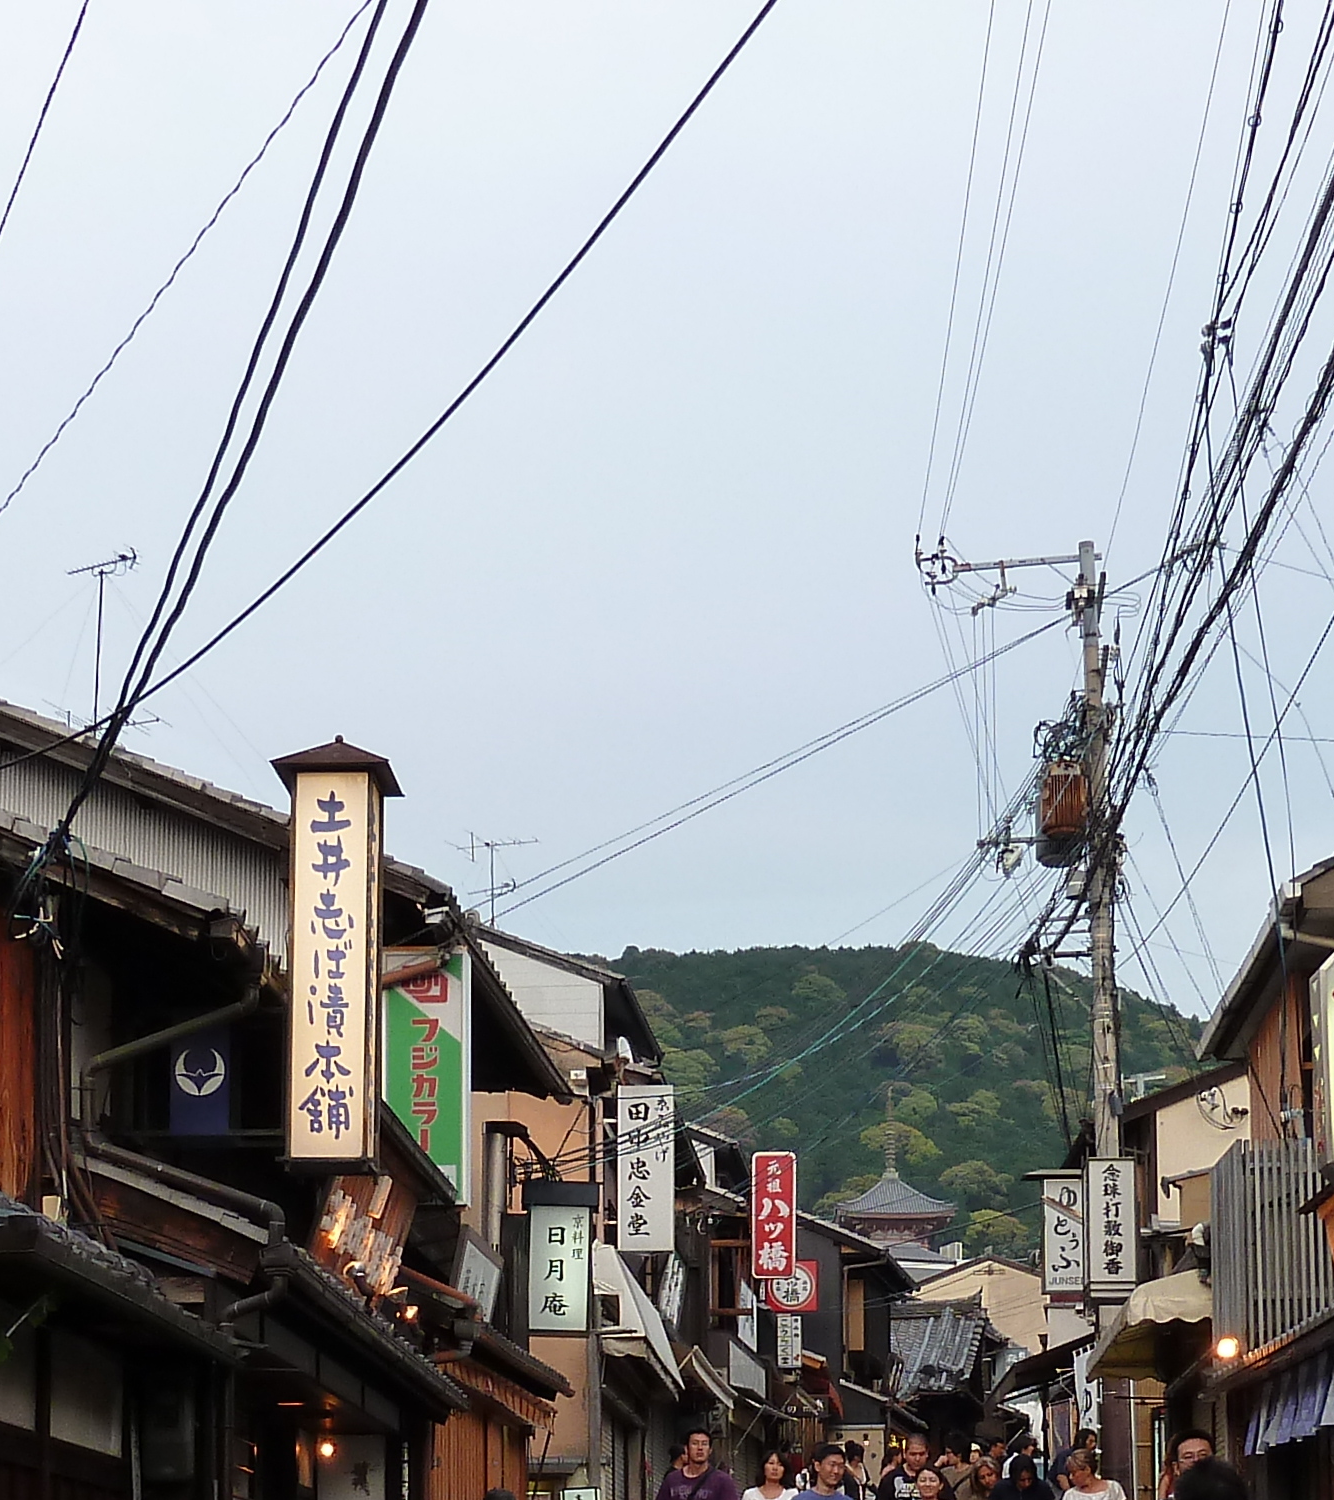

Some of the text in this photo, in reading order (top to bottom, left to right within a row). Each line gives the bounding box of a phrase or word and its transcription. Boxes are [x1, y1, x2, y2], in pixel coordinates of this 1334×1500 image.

[297, 790, 355, 1140] 土井志ば漬本舗
[411, 1017, 440, 1154] フジカラー
[539, 1226, 570, 1317] 日月庵
[571, 1213, 585, 1261] 京料理
[1051, 1186, 1081, 1273] ゆとうふ
